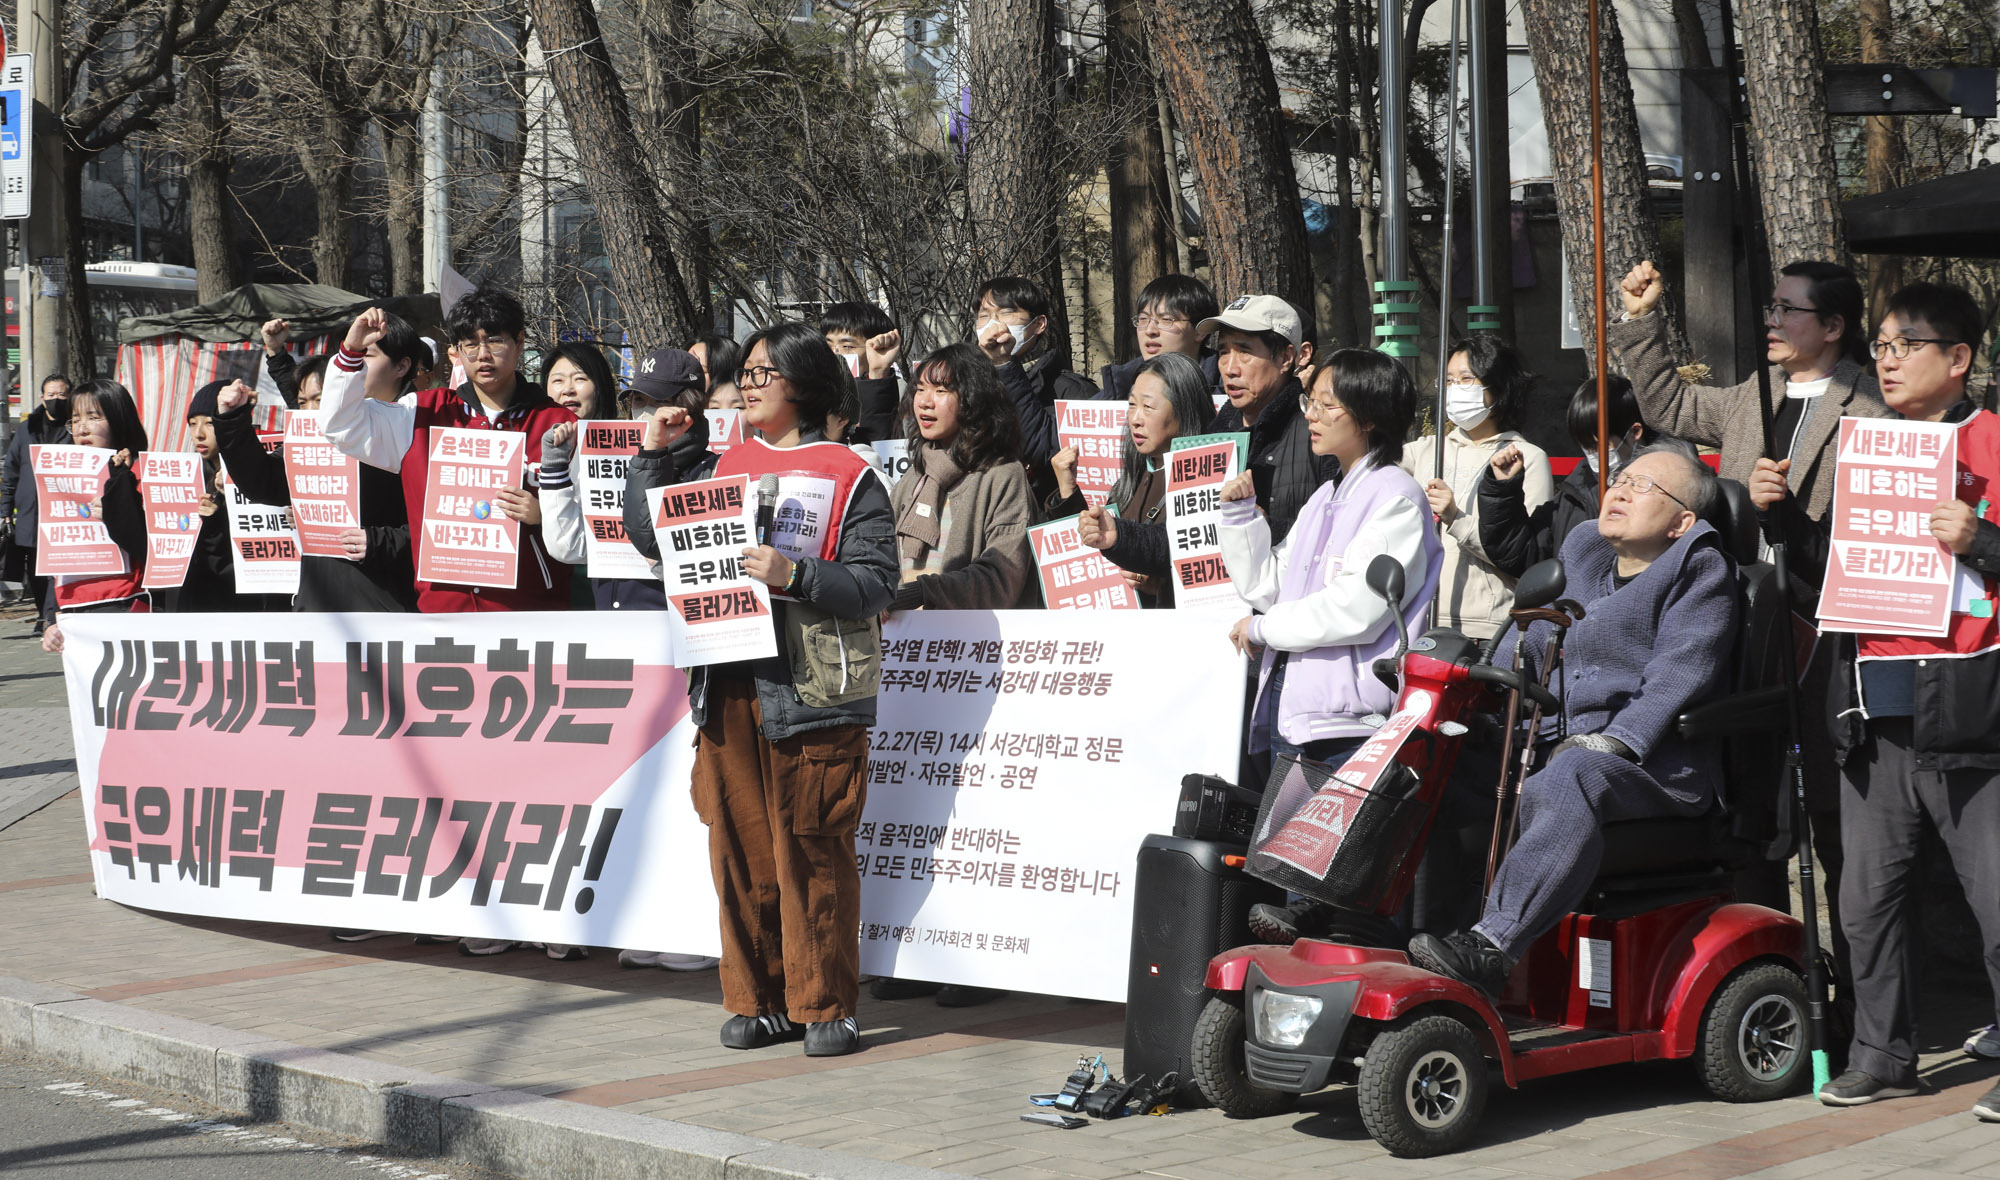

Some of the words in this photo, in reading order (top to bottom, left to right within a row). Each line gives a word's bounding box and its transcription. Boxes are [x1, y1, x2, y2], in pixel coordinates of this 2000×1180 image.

[291, 418, 324, 437] 내란
[586, 429, 641, 449] 내란세력
[441, 436, 491, 459] 윤석열
[498, 440, 508, 459] ?
[1853, 429, 1941, 460] 내란세력
[40, 452, 84, 469] 윤석열
[147, 459, 181, 477] 윤석열
[588, 459, 629, 480] 비호하
[1172, 452, 1227, 483] 내란세력
[44, 476, 99, 495] 몰아내고
[294, 474, 349, 496] 해체하라
[440, 465, 509, 489] 몰아내고
[1850, 468, 1938, 500] 비호하는
[149, 485, 199, 504] 몰아내고
[663, 485, 743, 519] 내란세력
[299, 503, 349, 524] 해체하라
[241, 540, 296, 559] 물러가라
[434, 524, 488, 548] 바꾸자
[671, 521, 748, 552] 비호하는
[1043, 528, 1079, 556] 내란
[1844, 546, 1939, 579] 물러가라
[683, 590, 758, 622] 물러가라
[925, 639, 966, 663] 탄핵!
[967, 640, 1003, 664] 계엄
[1006, 640, 1058, 665] 정당화
[1061, 641, 1105, 665] 규탄!
[91, 639, 316, 737] 내란세력
[338, 636, 634, 745] 비호하는
[880, 669, 931, 693] 주주의
[932, 669, 982, 694] 지키는
[985, 671, 1037, 695] 서강대
[1041, 671, 1113, 697] 대응행동
[949, 732, 987, 756] 14시
[990, 731, 1079, 760] 서강대학교
[1084, 735, 1124, 764] 정문
[918, 760, 986, 788] 자유발언
[1000, 764, 1038, 790] 공연
[101, 784, 285, 892] 극우세력
[301, 792, 624, 915] 물러가라!
[855, 822, 877, 847] 적
[879, 822, 947, 850] 움직임에
[951, 826, 1021, 856] 반대하는
[872, 855, 906, 880] 모든
[910, 856, 1016, 888] 민주주의자를
[1020, 863, 1121, 898] 환영합니다
[868, 923, 890, 941] 철거
[892, 925, 916, 943] 예정
[924, 928, 972, 949] 기자회견
[975, 932, 988, 951] 및
[991, 936, 1030, 955] 문화제
